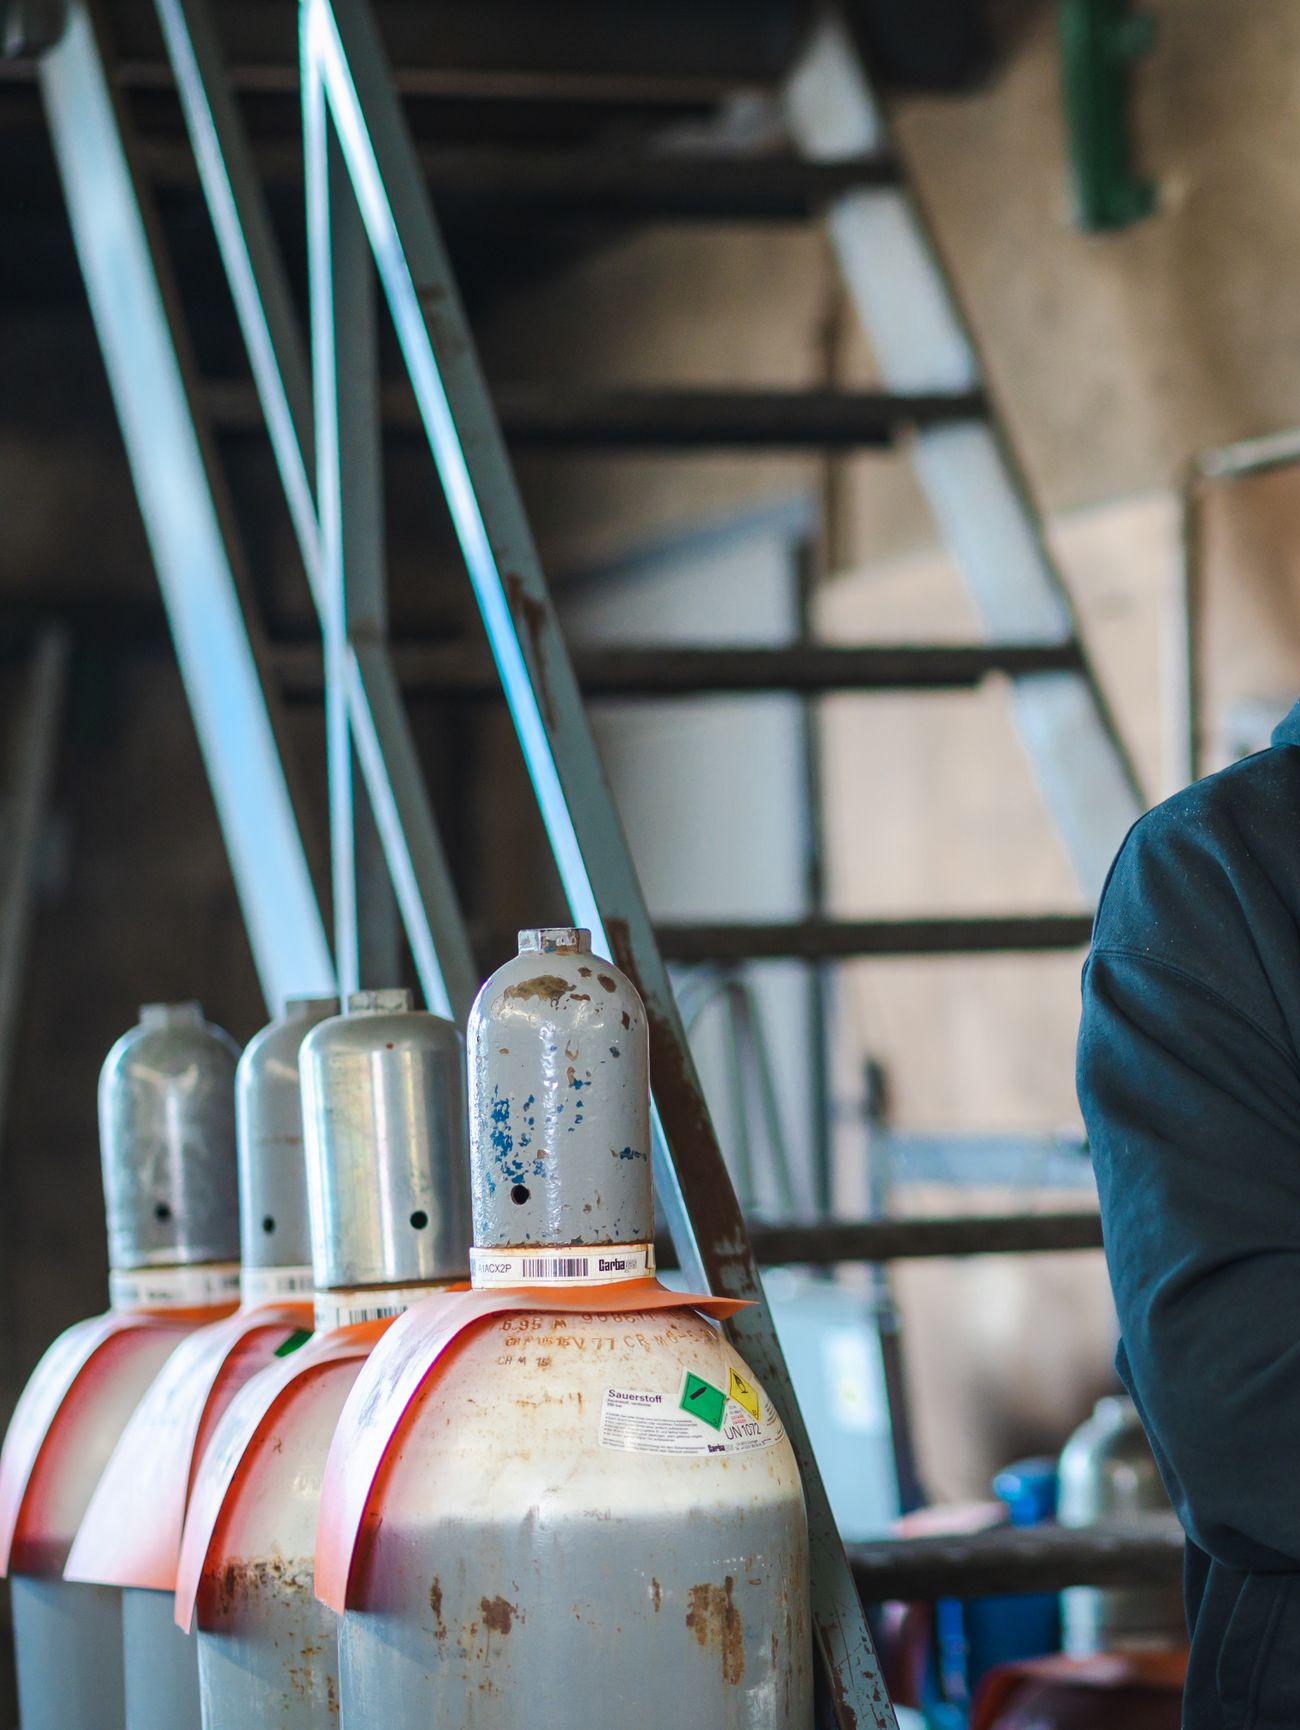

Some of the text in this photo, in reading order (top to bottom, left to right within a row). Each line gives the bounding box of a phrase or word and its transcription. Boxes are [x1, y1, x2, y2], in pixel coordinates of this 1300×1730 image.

[608, 1389, 662, 1404] Sauerstoff
[724, 1425, 742, 1440] UN
[742, 1422, 761, 1437] 1072
